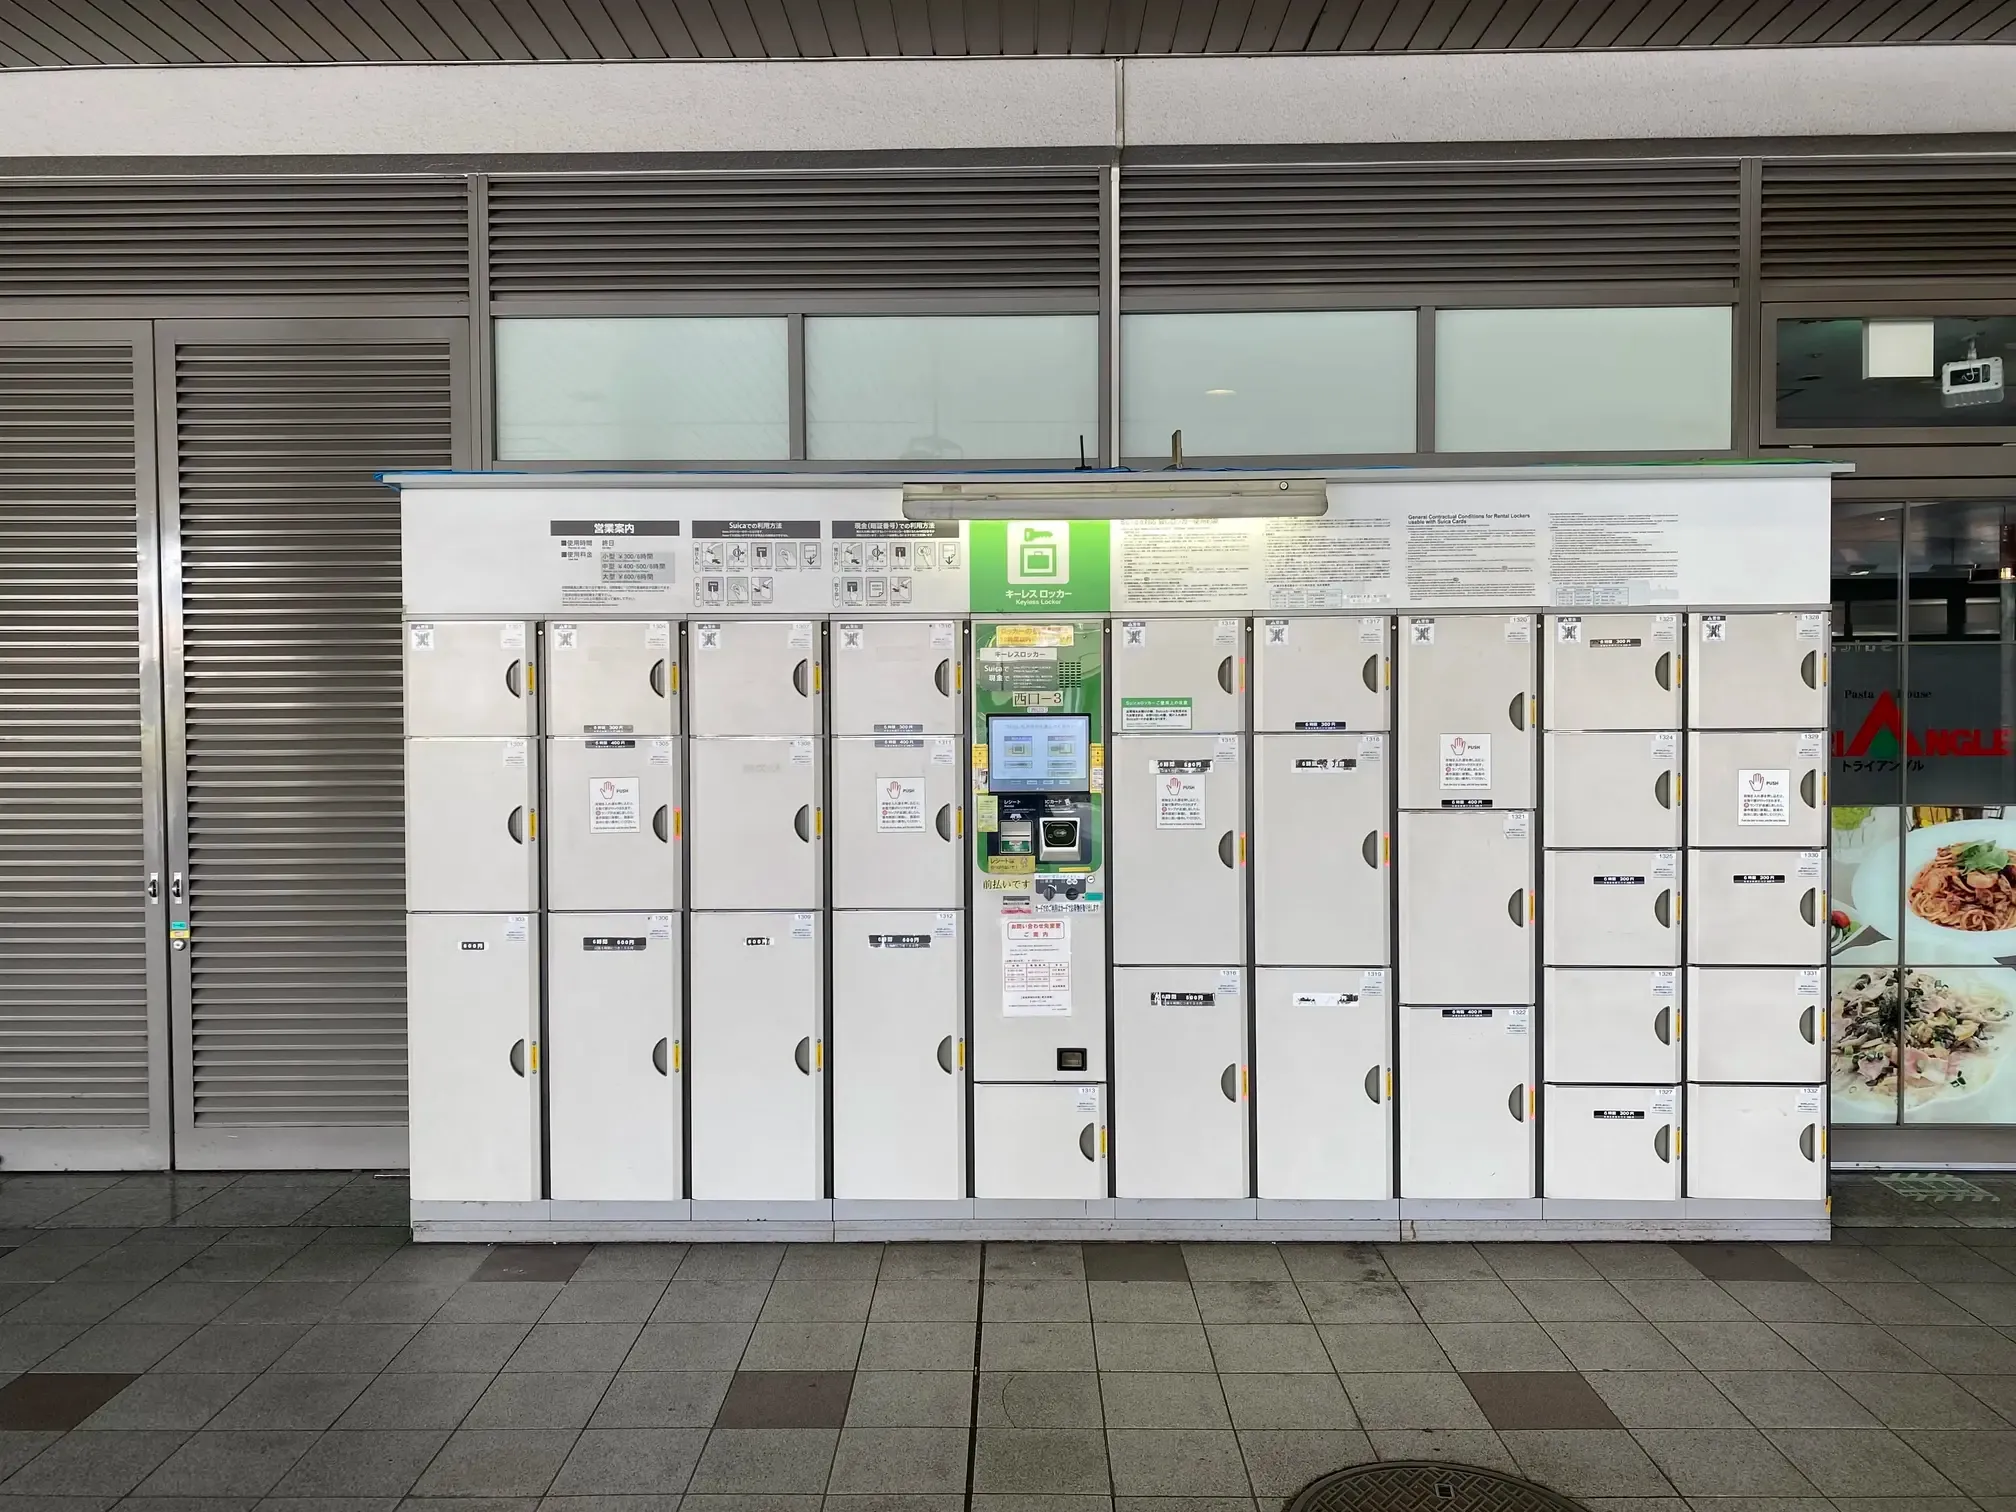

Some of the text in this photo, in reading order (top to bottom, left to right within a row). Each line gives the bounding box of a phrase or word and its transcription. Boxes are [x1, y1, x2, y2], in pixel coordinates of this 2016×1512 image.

[594, 523, 635, 534] 営業案内
[729, 522, 783, 530] Suicaでの利用方法
[988, 674, 1010, 682] 現金で
[1844, 689, 1875, 699] Pasta
[1832, 688, 2012, 757] IANGLE
[983, 879, 1031, 891] 前払いです
